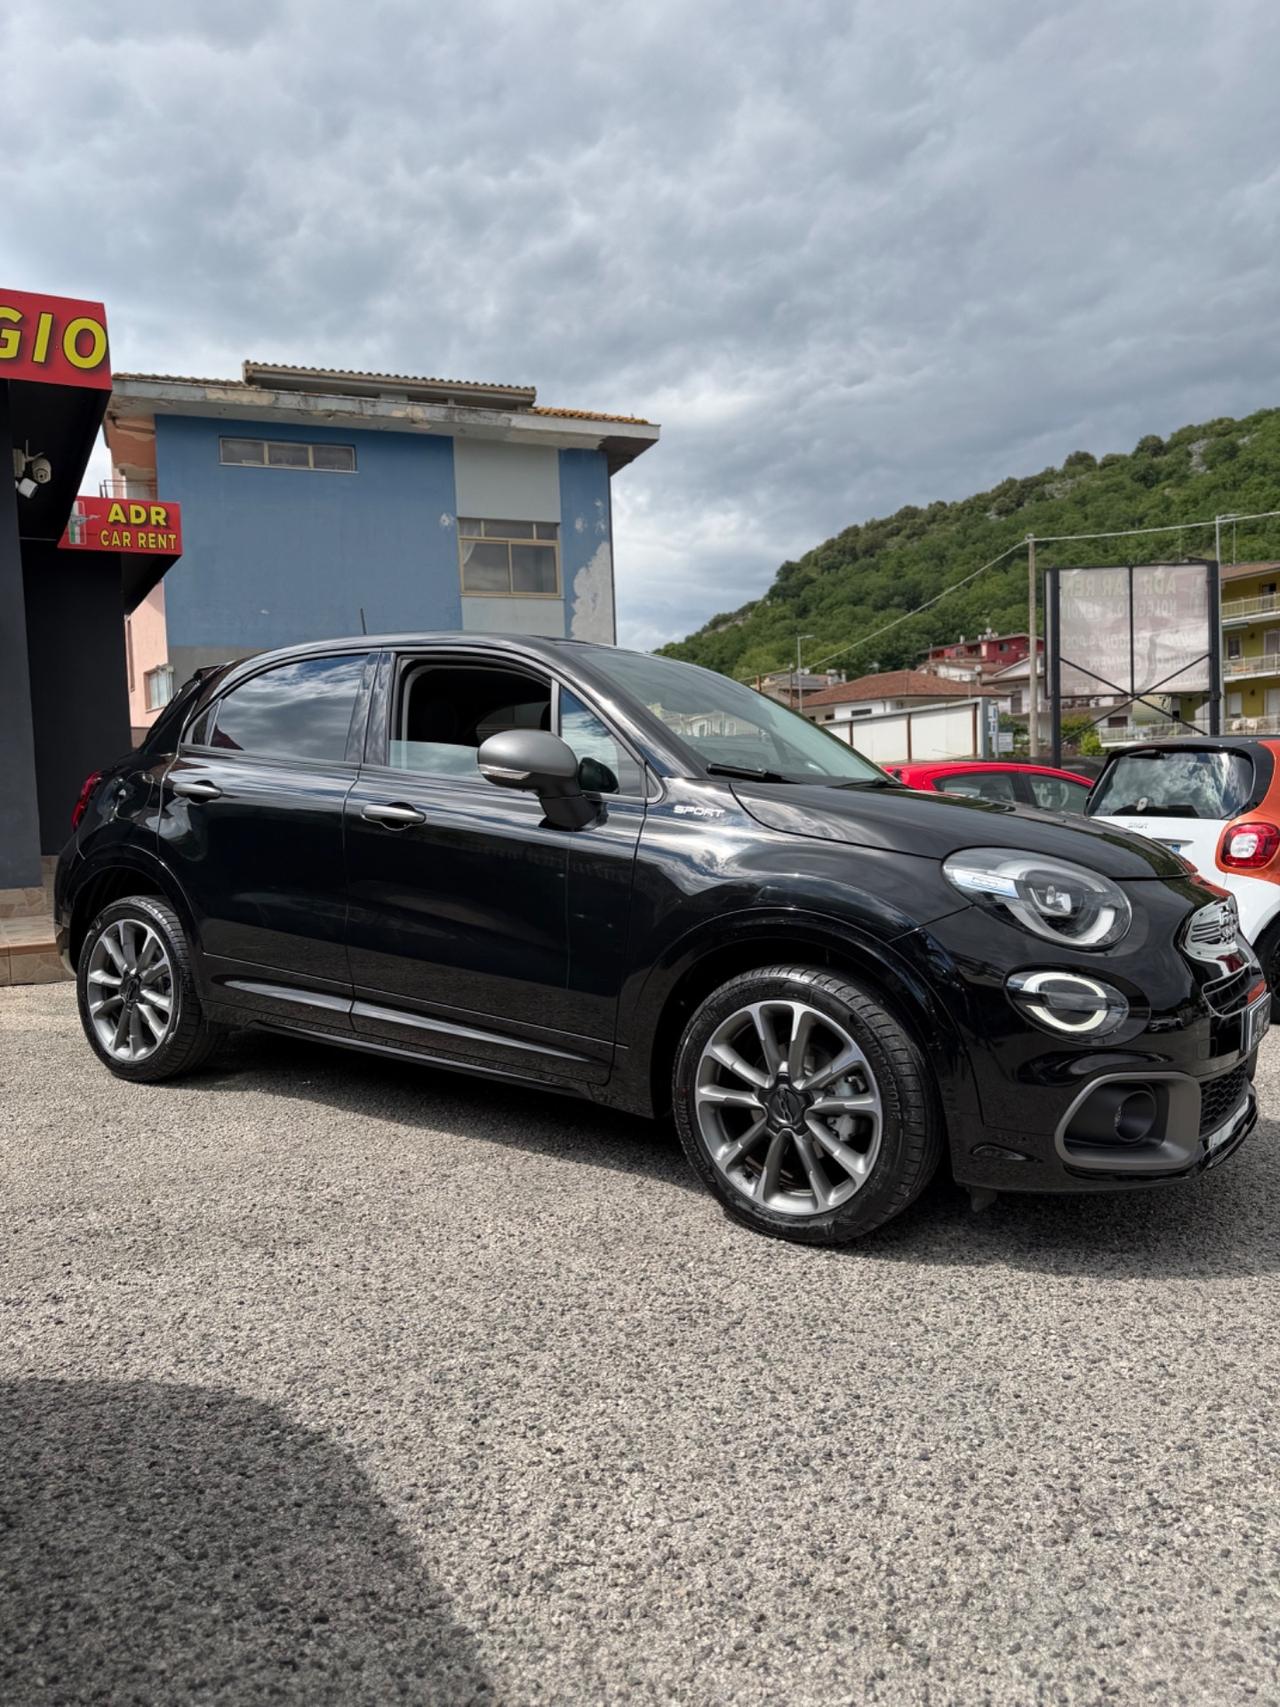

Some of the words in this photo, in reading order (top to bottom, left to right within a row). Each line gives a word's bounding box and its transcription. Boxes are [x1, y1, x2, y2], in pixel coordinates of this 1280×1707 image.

[107, 502, 167, 526] ADR
[100, 529, 131, 547] CAR
[137, 532, 176, 549] RENT
[673, 804, 725, 817] SPORT
